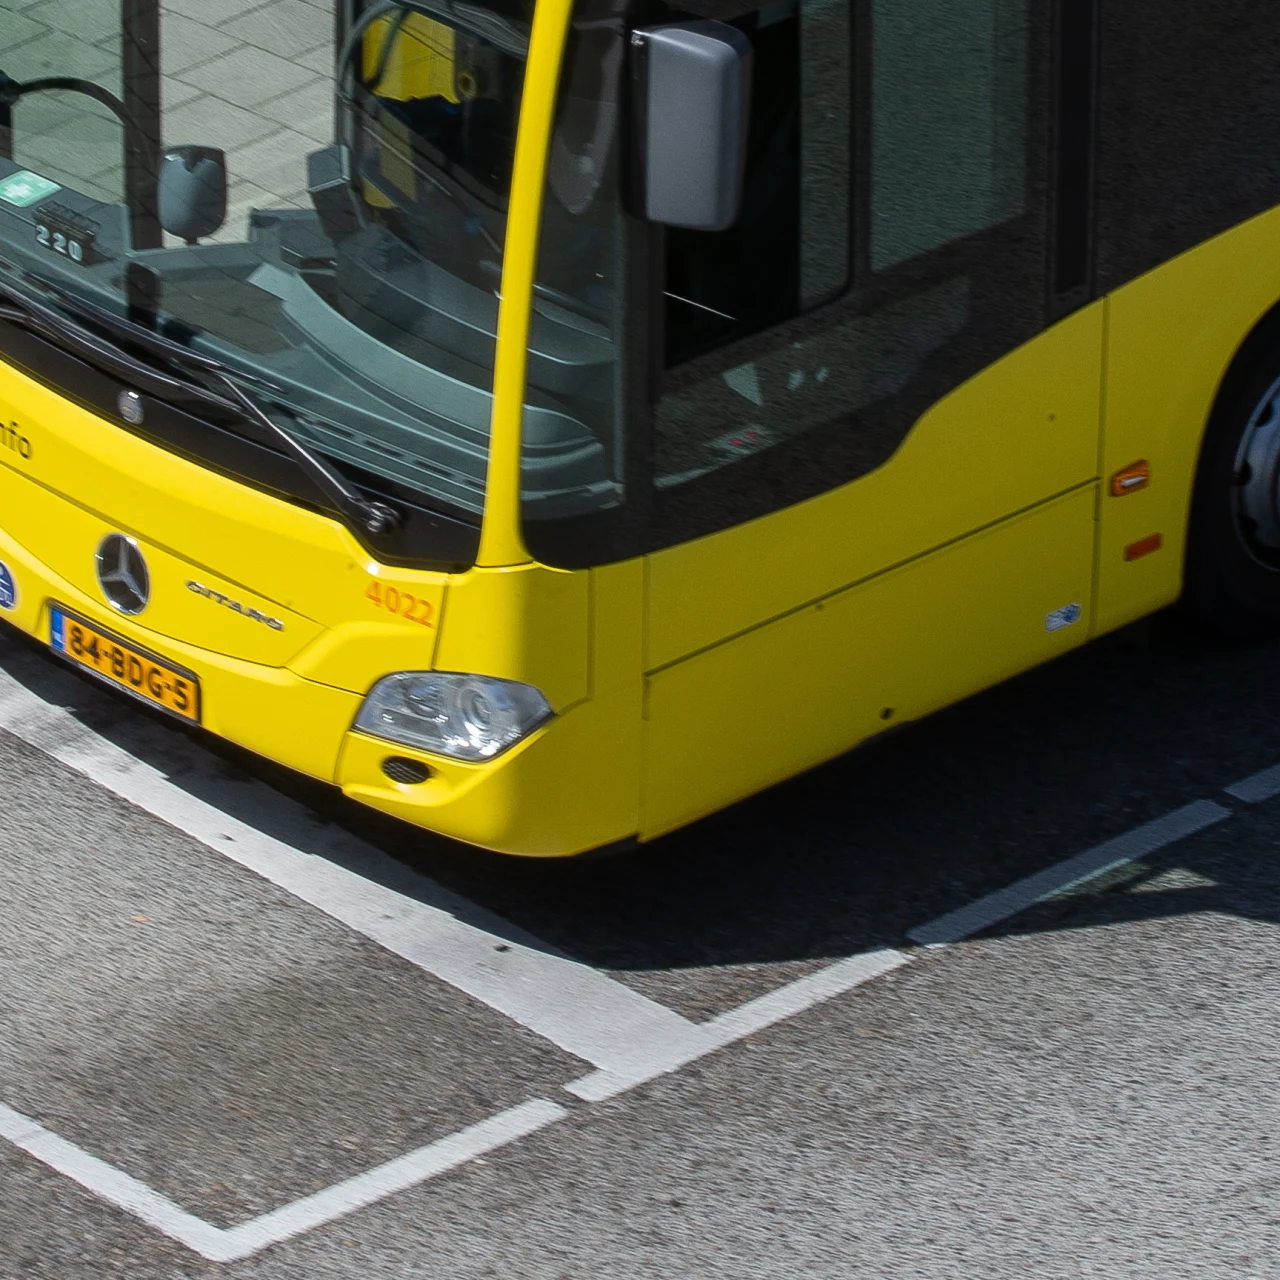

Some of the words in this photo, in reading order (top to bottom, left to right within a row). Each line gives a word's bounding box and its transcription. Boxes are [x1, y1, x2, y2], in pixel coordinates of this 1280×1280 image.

[34, 224, 83, 262] 220
[365, 581, 435, 628] 4022
[70, 625, 190, 711] 84-BDG-5
